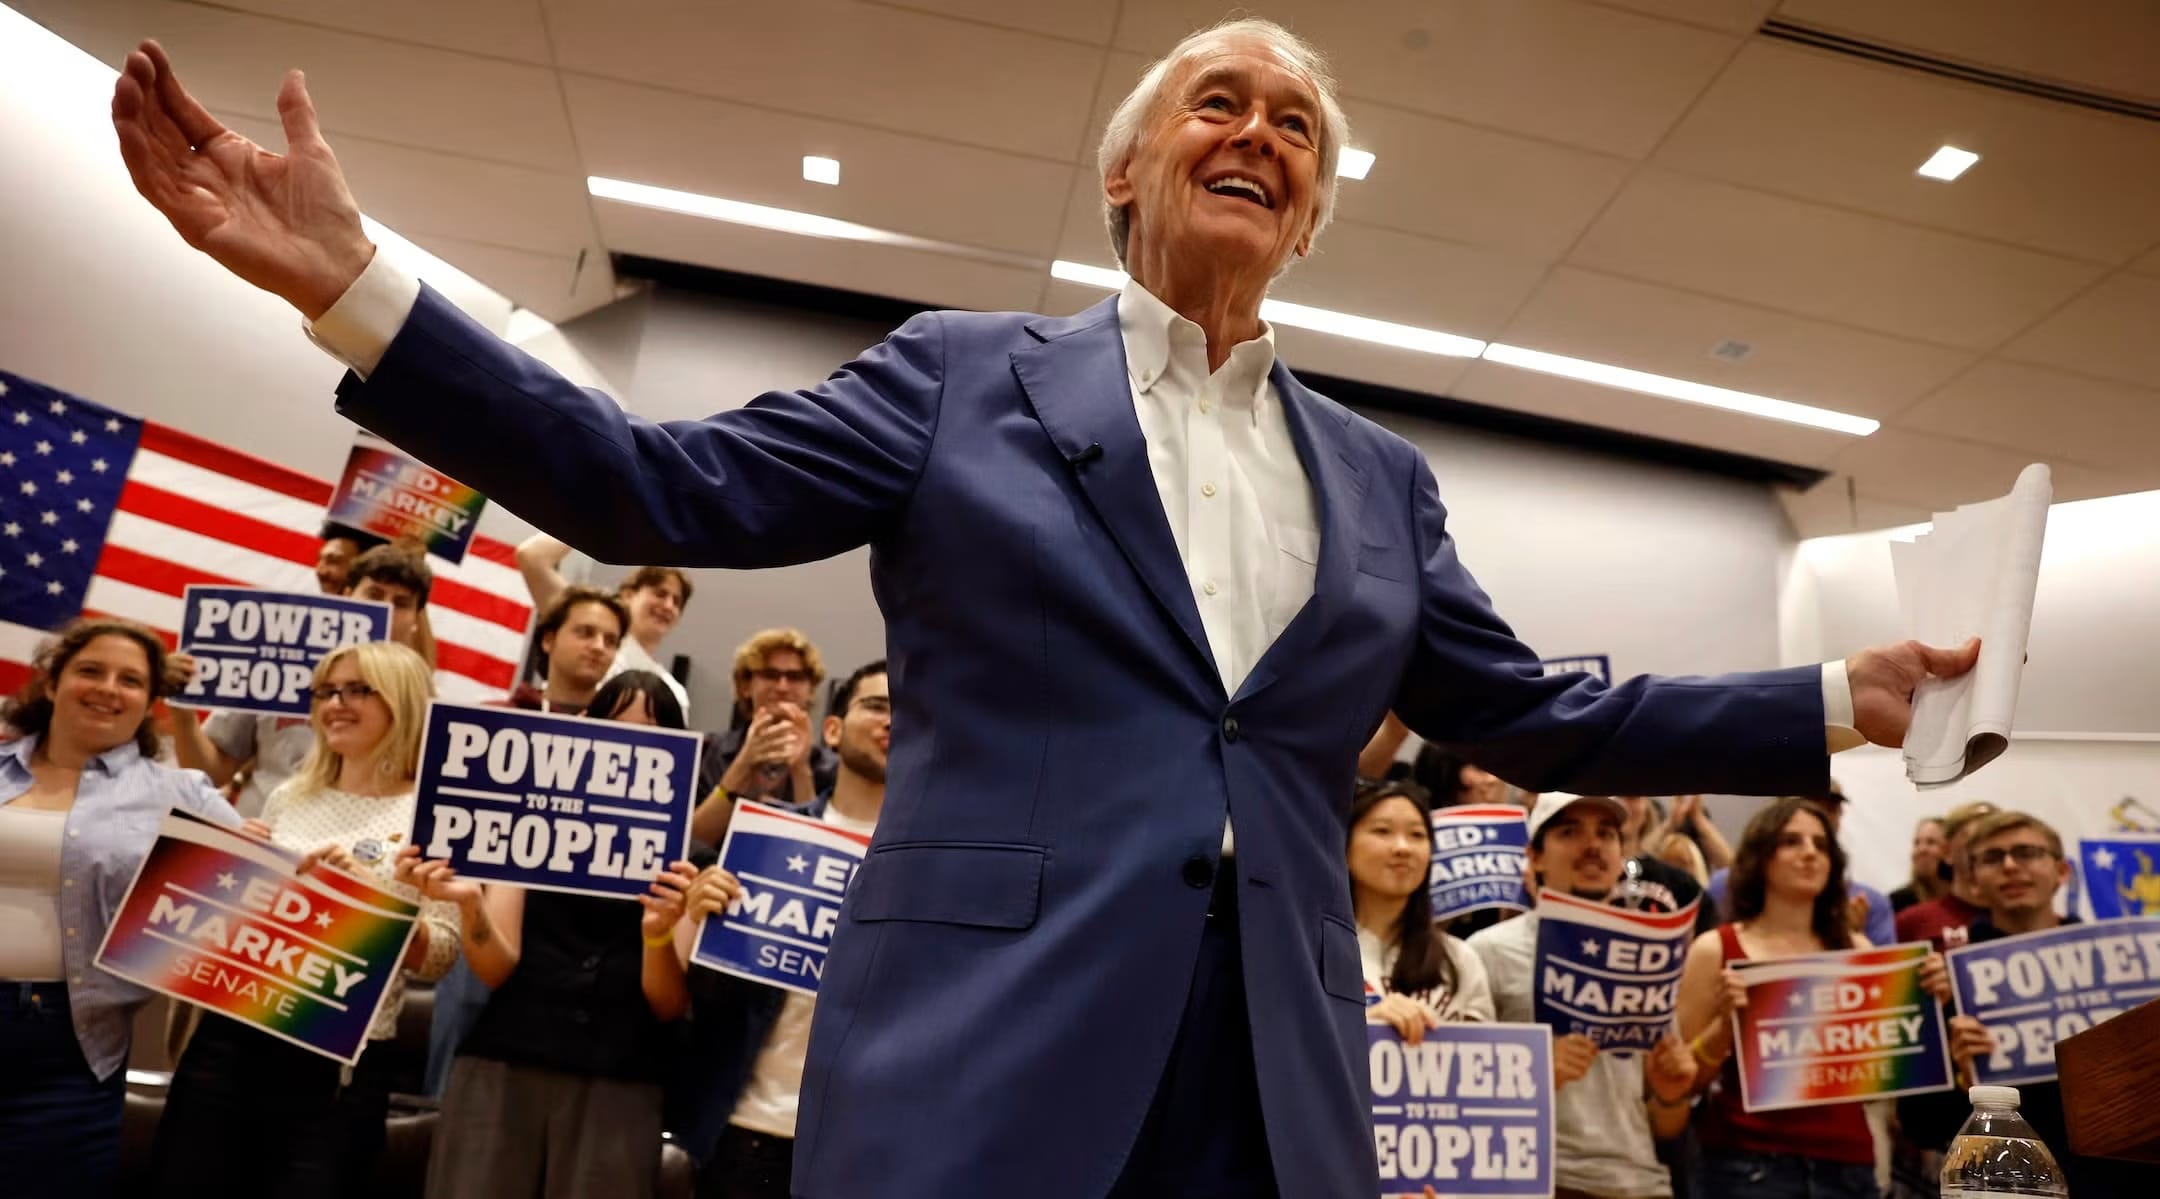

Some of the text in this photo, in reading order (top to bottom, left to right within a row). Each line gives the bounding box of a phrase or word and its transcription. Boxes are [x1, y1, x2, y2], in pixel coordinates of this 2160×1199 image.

[399, 464, 439, 492] ED
[352, 476, 468, 534] MARKEY
[194, 598, 373, 648] POWER
[260, 646, 277, 659] TO
[184, 655, 313, 703] PEOP
[441, 721, 675, 804] POWER
[526, 793, 584, 814] TO THE
[426, 804, 667, 882] PEOPLE
[1435, 826, 1483, 850] ED
[812, 855, 860, 892] E
[240, 876, 311, 922] ED
[727, 886, 839, 939] MAR
[148, 894, 366, 998] MARKEY
[757, 945, 825, 980] SEN
[1606, 940, 1671, 972] ED
[172, 955, 298, 1018] SENATE
[1544, 966, 1678, 1014] MARK
[1810, 983, 1866, 1012] ED
[1757, 1015, 1924, 1058] MARKEY
[1369, 1039, 1537, 1099] OWER
[1406, 1103, 1458, 1119] TO THE
[1374, 1124, 1538, 1180] EOPLE
